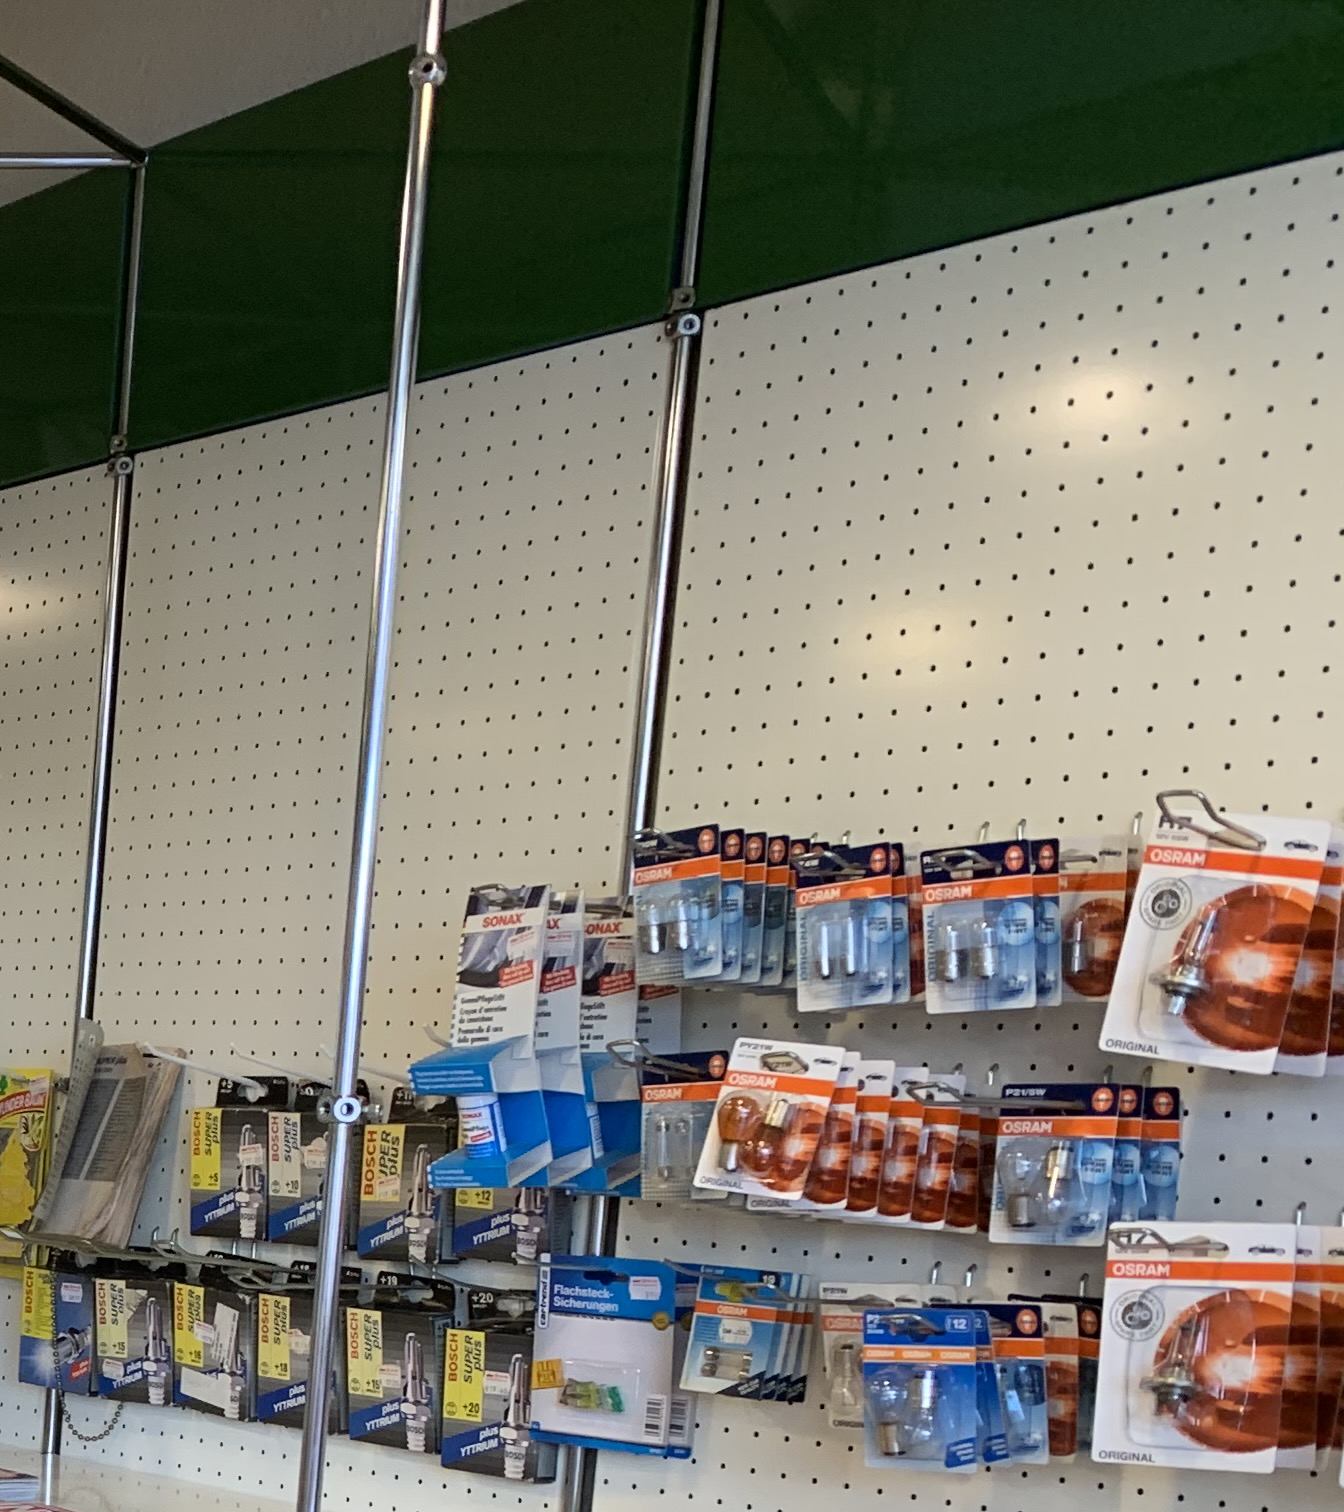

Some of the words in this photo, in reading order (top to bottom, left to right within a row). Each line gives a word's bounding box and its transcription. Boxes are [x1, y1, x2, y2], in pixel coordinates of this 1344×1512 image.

[1150, 848, 1206, 866] OSRAM
[634, 867, 673, 884] OSRAM
[798, 887, 841, 905] OSRAM
[924, 885, 973, 902] OSRAM
[482, 913, 525, 928] SONAX
[1105, 1037, 1160, 1056] ORIGINAL
[728, 1072, 777, 1089] OSRAM
[193, 1111, 201, 1156] BOSCH
[205, 1111, 213, 1156] SUPER
[271, 1115, 279, 1162] BOSCH
[292, 1120, 300, 1151] plus
[1002, 1121, 1053, 1136] OSRAM
[284, 1116, 292, 1163] SUPER
[364, 1129, 378, 1196] BOSCH
[285, 1180, 300, 1191] +10
[699, 1176, 744, 1192] ORIGINAL
[474, 1190, 492, 1202] +12
[370, 1225, 404, 1249] YTTRIUM
[472, 1224, 511, 1246] YTTRIUM
[1112, 1263, 1170, 1277] OSRAM
[25, 1270, 34, 1314] BOSCH
[471, 1291, 494, 1304] +20
[553, 1283, 615, 1301] Flachsteck-
[111, 1282, 119, 1326] SUPER
[177, 1287, 185, 1331] BOSCH
[552, 1294, 620, 1313] Sicherungen
[262, 1297, 270, 1344] BOSCH
[273, 1299, 281, 1345] SUPER
[350, 1311, 360, 1360] BOSCH
[364, 1312, 373, 1362] SUPER
[372, 1318, 381, 1351] plus
[448, 1332, 459, 1383] BOSCH
[464, 1334, 474, 1385] SUPER
[474, 1339, 485, 1373] plus
[112, 1371, 144, 1389] YTTRIUM
[289, 1382, 306, 1397] plus
[273, 1394, 306, 1414] YTTRIUM
[380, 1401, 400, 1419] plus
[462, 1401, 481, 1415] +20
[365, 1412, 401, 1432] YTTRIUM
[478, 1426, 500, 1443] plus
[459, 1436, 500, 1458] YTTRIUM
[1098, 1449, 1156, 1463] ORIGINAL
